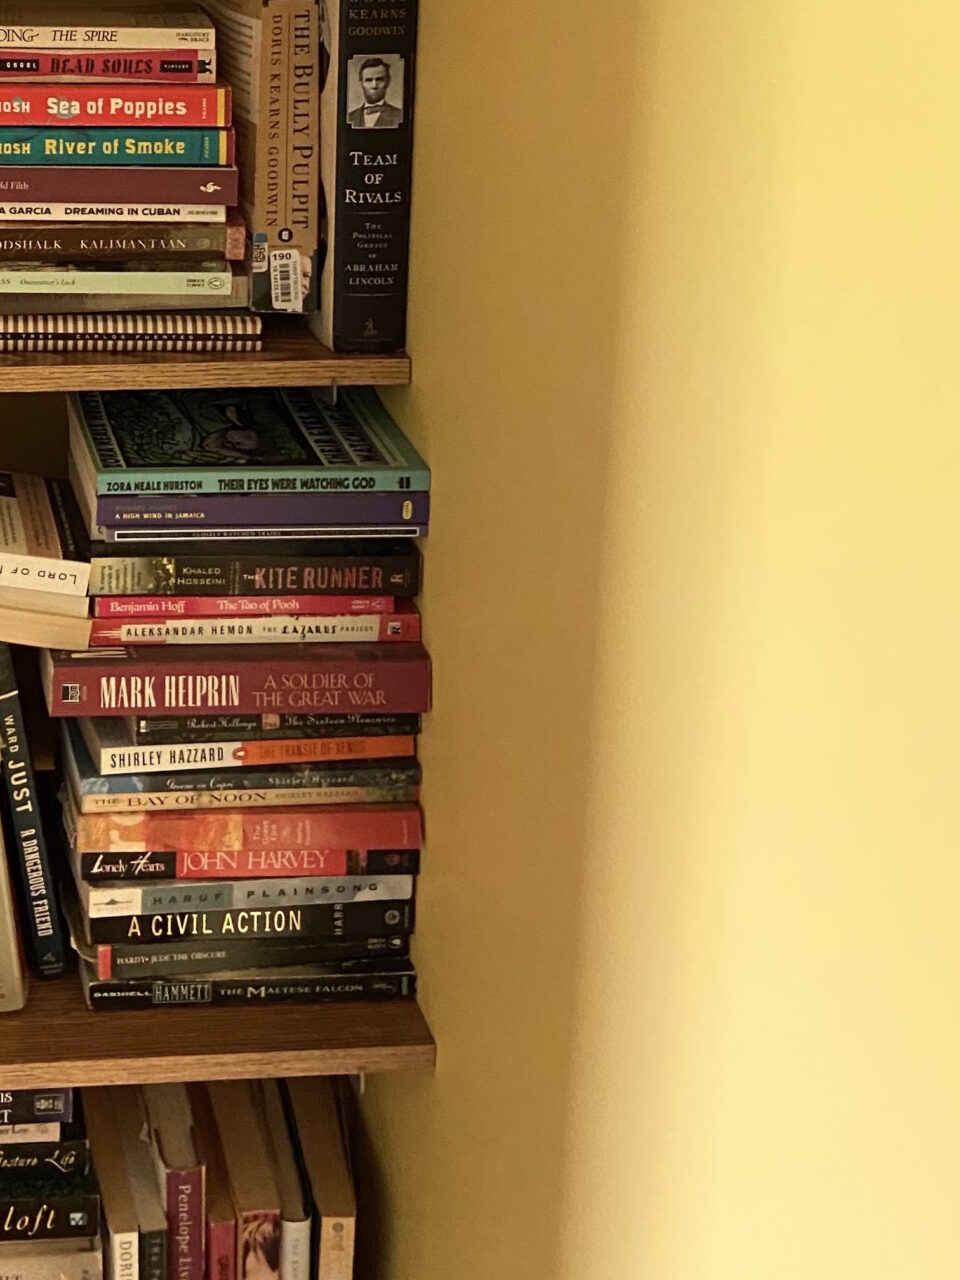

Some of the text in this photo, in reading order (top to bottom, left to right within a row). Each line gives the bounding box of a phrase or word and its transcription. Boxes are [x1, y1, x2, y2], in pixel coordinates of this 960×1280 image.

[295, 9, 309, 55] THE
[47, 97, 81, 115] Sea
[86, 97, 104, 114] of
[110, 97, 187, 118] Poppies
[44, 138, 97, 155] River
[103, 138, 119, 154] of
[125, 138, 185, 154] Smoke
[365, 173, 383, 185] OF
[9, 207, 51, 215] GARCIA
[64, 207, 123, 216] DREAMING
[127, 207, 138, 215] IN
[142, 207, 180, 216] CUBAN
[271, 252, 292, 261] 190
[106, 480, 203, 492] ZORA NEALE HURSTON
[218, 477, 376, 491] THEIR EYES WERE WATCHING GOD
[175, 511, 205, 519] JAMAICA
[10, 567, 30, 576] OF
[100, 675, 239, 708] MARK HELPRIN
[5, 714, 32, 813] WARD JUST
[110, 747, 224, 768] SHIRLEY HAZZARD
[180, 850, 330, 872] JOHN HARVEY
[128, 910, 301, 937] A CIVIL ACTION
[179, 1184, 190, 1254] Penelope
